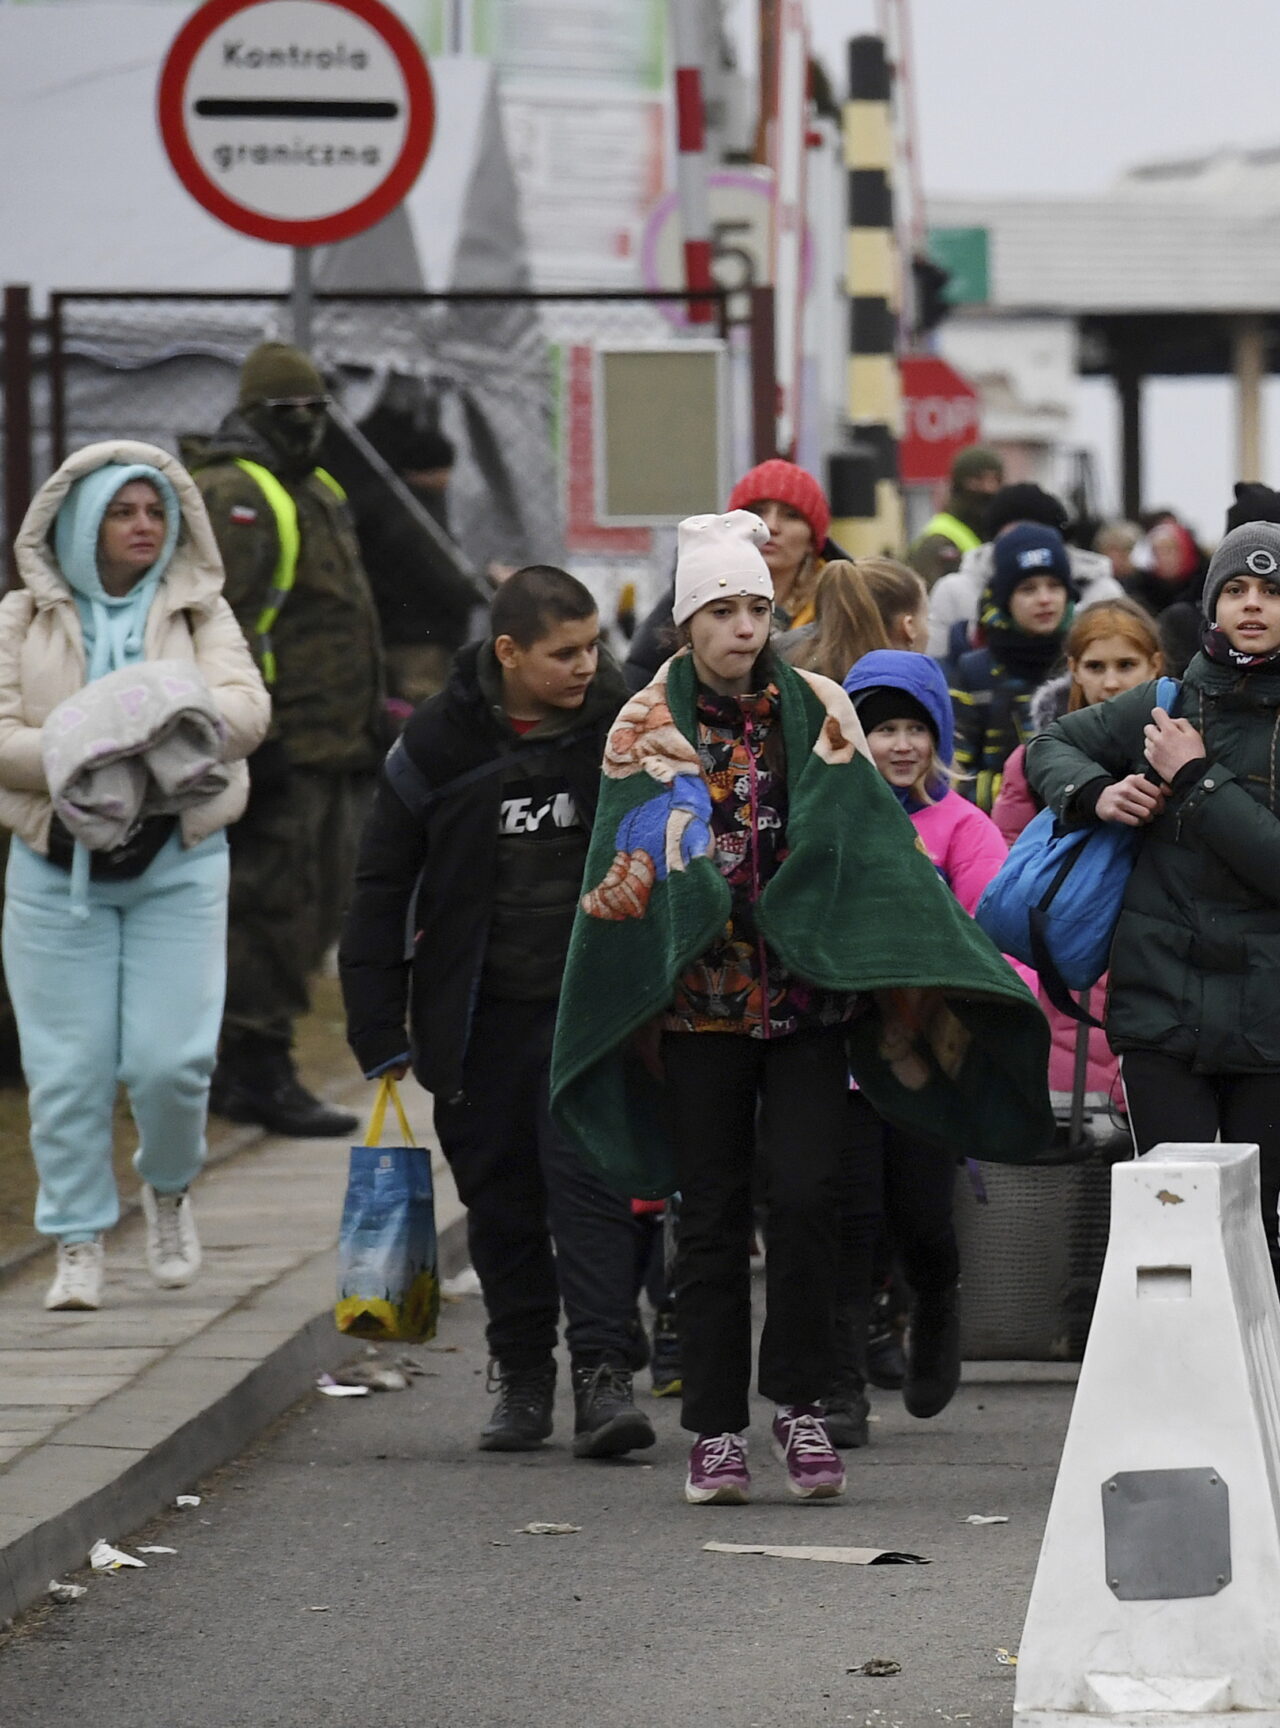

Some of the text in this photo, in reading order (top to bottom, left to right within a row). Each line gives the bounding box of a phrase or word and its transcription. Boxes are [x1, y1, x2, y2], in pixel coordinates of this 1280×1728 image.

[222, 40, 370, 71] Kontrola
[212, 138, 381, 173] graniczna
[710, 218, 756, 294] 5
[898, 395, 978, 442] TOP
